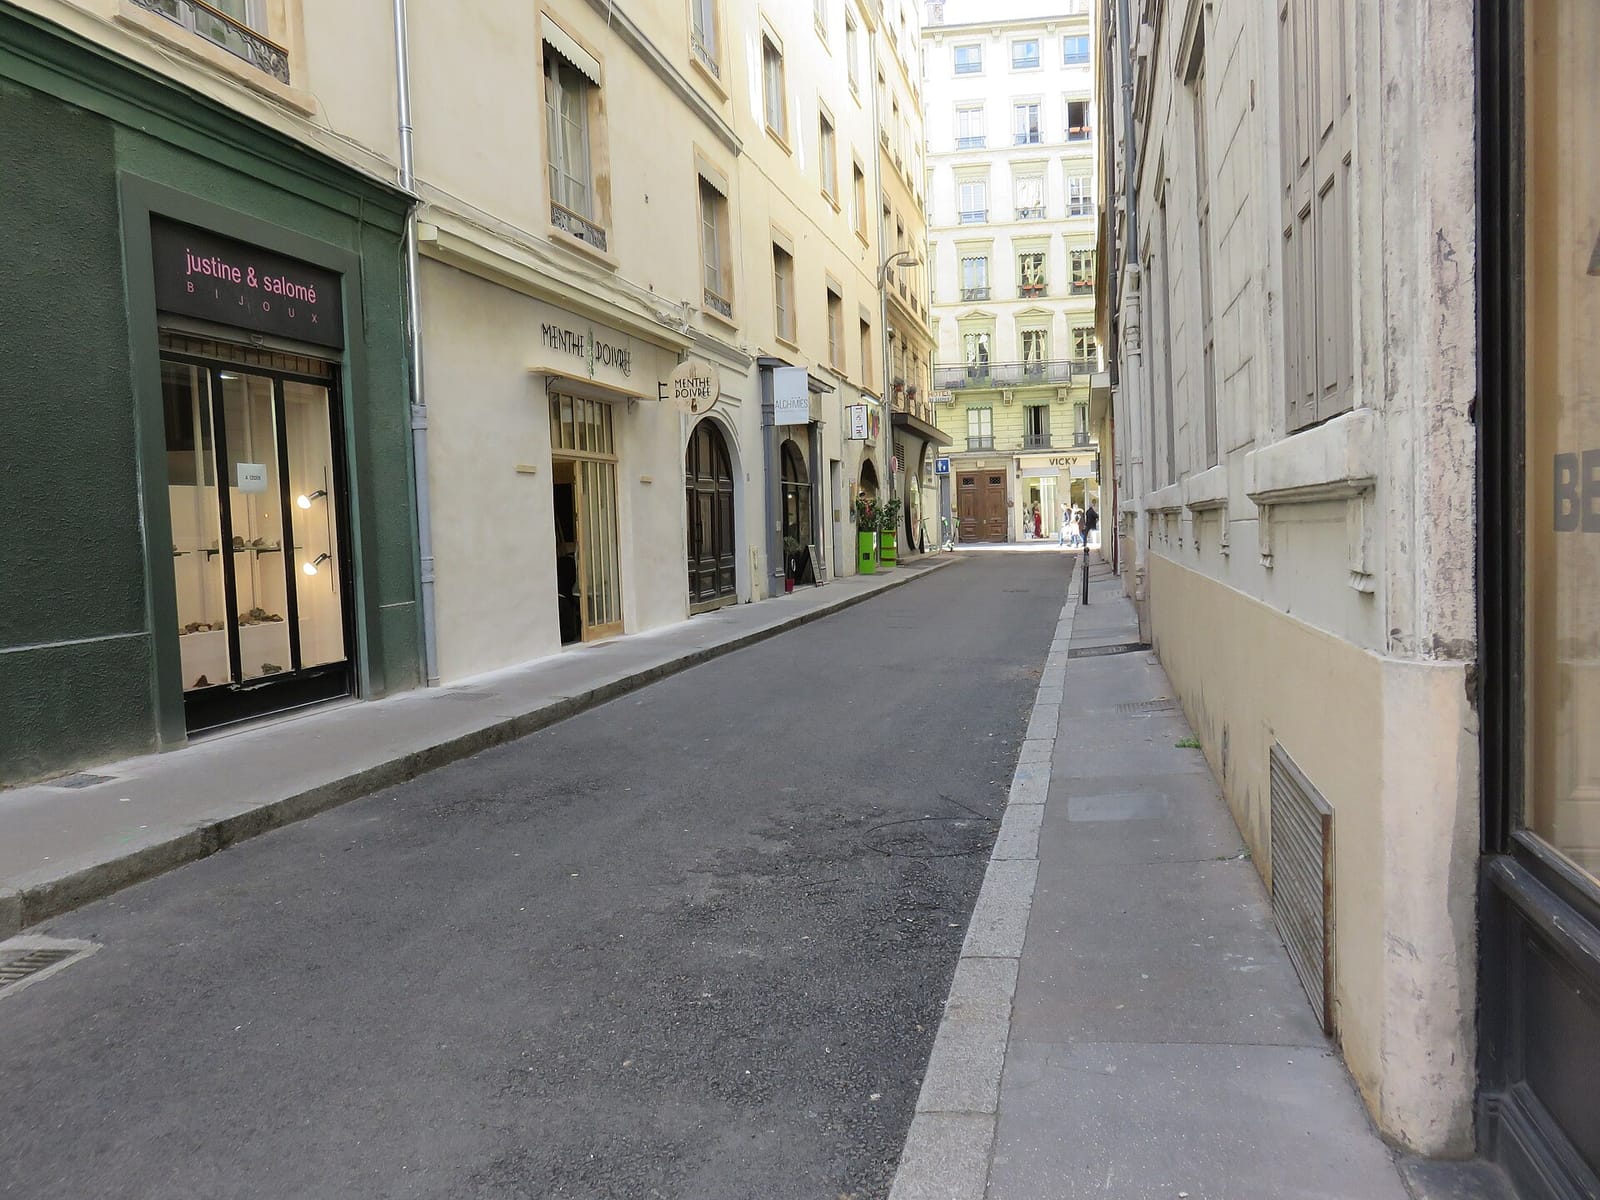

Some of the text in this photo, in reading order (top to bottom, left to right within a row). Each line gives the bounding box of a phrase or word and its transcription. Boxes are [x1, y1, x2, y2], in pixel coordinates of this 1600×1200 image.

[186, 248, 317, 304] justine & salomé
[187, 281, 318, 324] BIJOUX
[541, 322, 584, 358] MENTHE
[674, 377, 710, 388] MENTHE
[1049, 457, 1078, 466] VICKY
